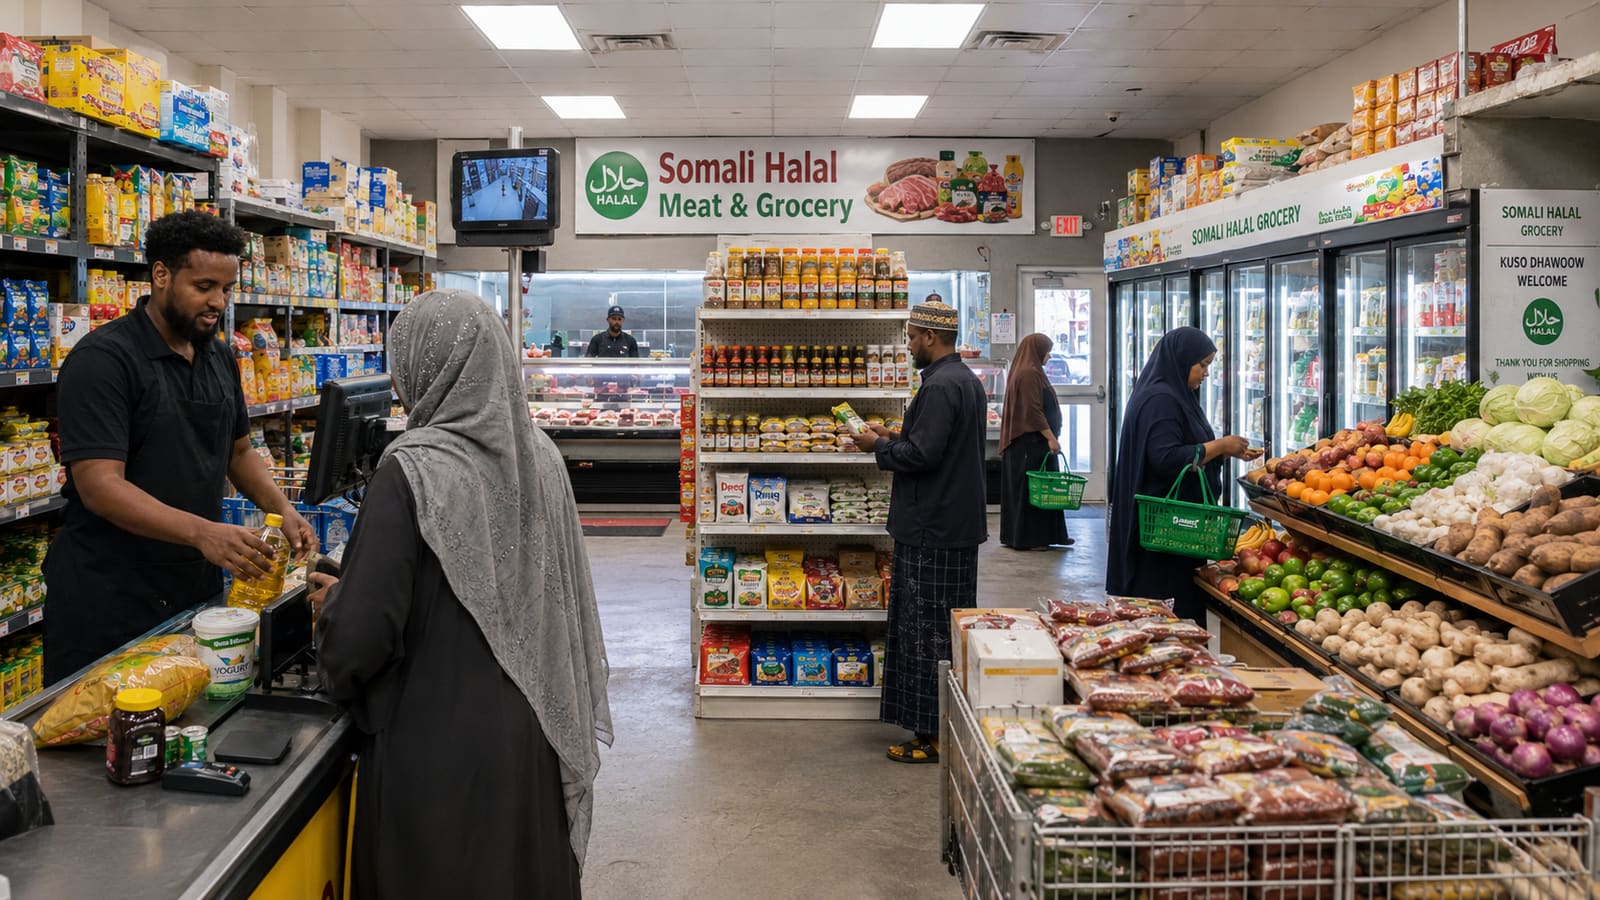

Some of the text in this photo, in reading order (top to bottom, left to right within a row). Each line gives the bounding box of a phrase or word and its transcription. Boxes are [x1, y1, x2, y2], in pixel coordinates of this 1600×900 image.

[658, 150, 837, 184] Somali Halal
[589, 165, 645, 193] حلال
[597, 194, 638, 205] HALAL
[659, 192, 854, 224] Meat & Grocery
[1502, 206, 1582, 219] SOMALI HALAL
[1056, 216, 1079, 235] EXIT
[1192, 223, 1224, 246] SOMALI
[1226, 216, 1255, 238] HALAL
[1256, 204, 1301, 231] GROCERY
[1520, 225, 1564, 237] GROCERY
[1500, 256, 1585, 268] KUSO DHAWOOW
[1517, 275, 1568, 287] WELCOME
[1525, 307, 1561, 327] حلال
[1530, 328, 1557, 336] HALAL
[1495, 358, 1591, 367] THANK YOU FOR SHOPPING
[214, 662, 249, 675] YOGURT
